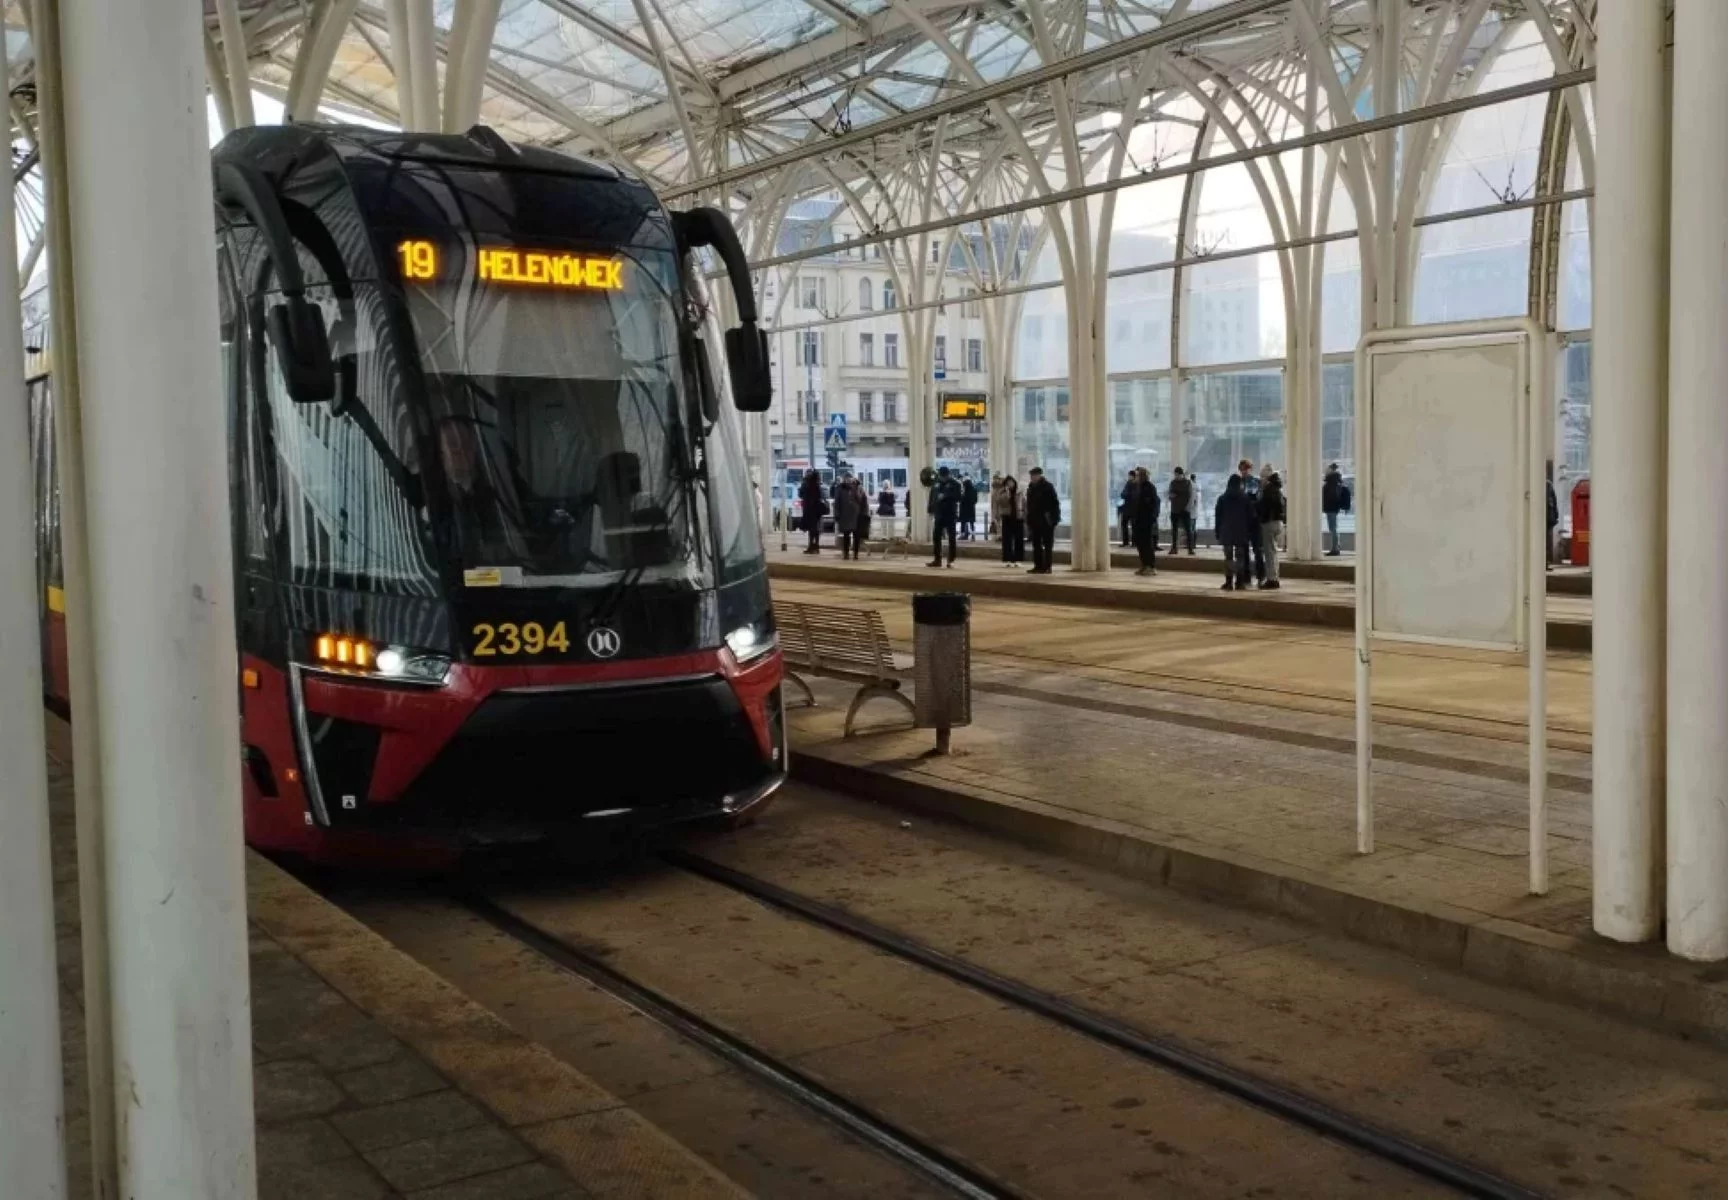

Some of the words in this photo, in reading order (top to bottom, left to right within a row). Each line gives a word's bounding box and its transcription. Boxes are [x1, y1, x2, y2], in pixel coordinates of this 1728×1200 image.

[400, 240, 436, 279] 19
[478, 248, 624, 290] HELENÓWEK
[472, 621, 570, 656] 2394
